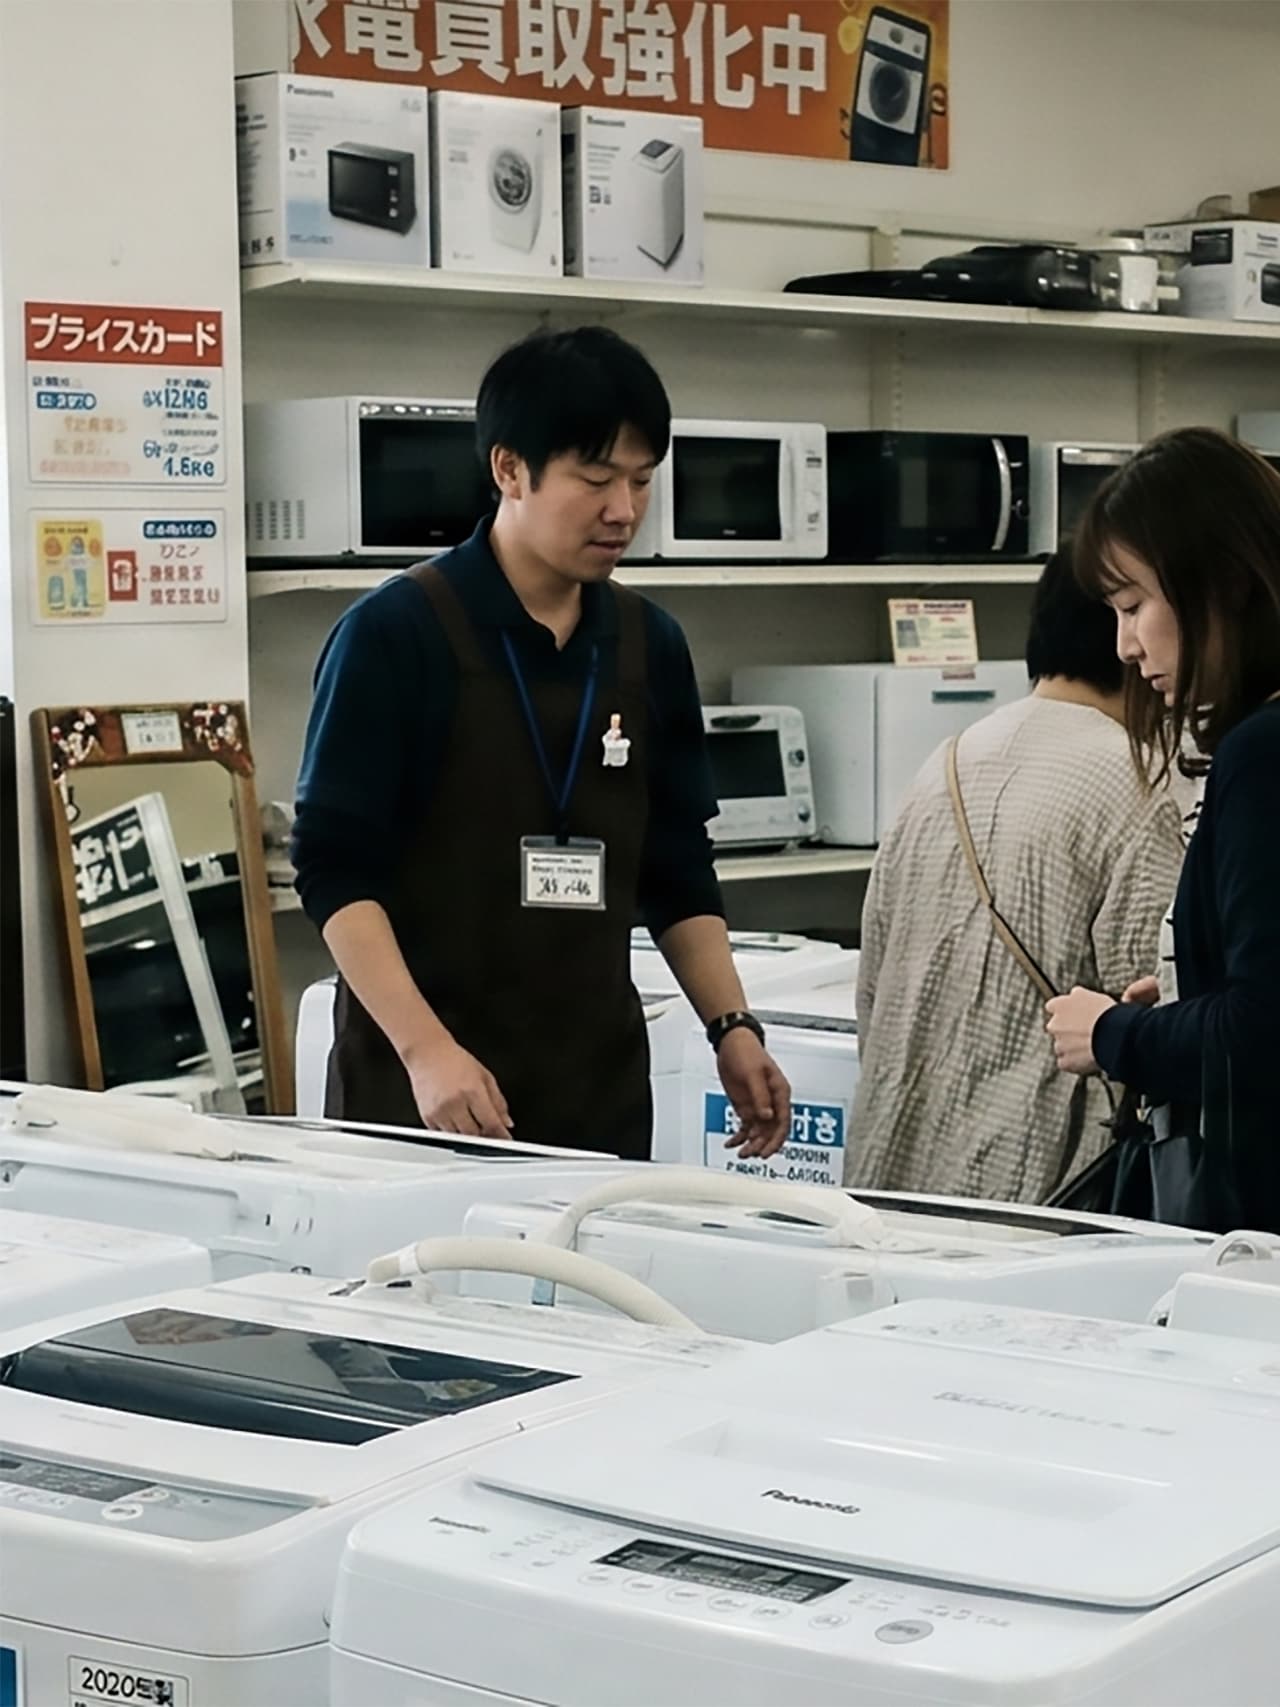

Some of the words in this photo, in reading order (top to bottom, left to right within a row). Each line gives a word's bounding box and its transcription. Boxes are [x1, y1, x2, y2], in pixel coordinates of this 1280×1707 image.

[293, 0, 827, 116] 電買取強化中
